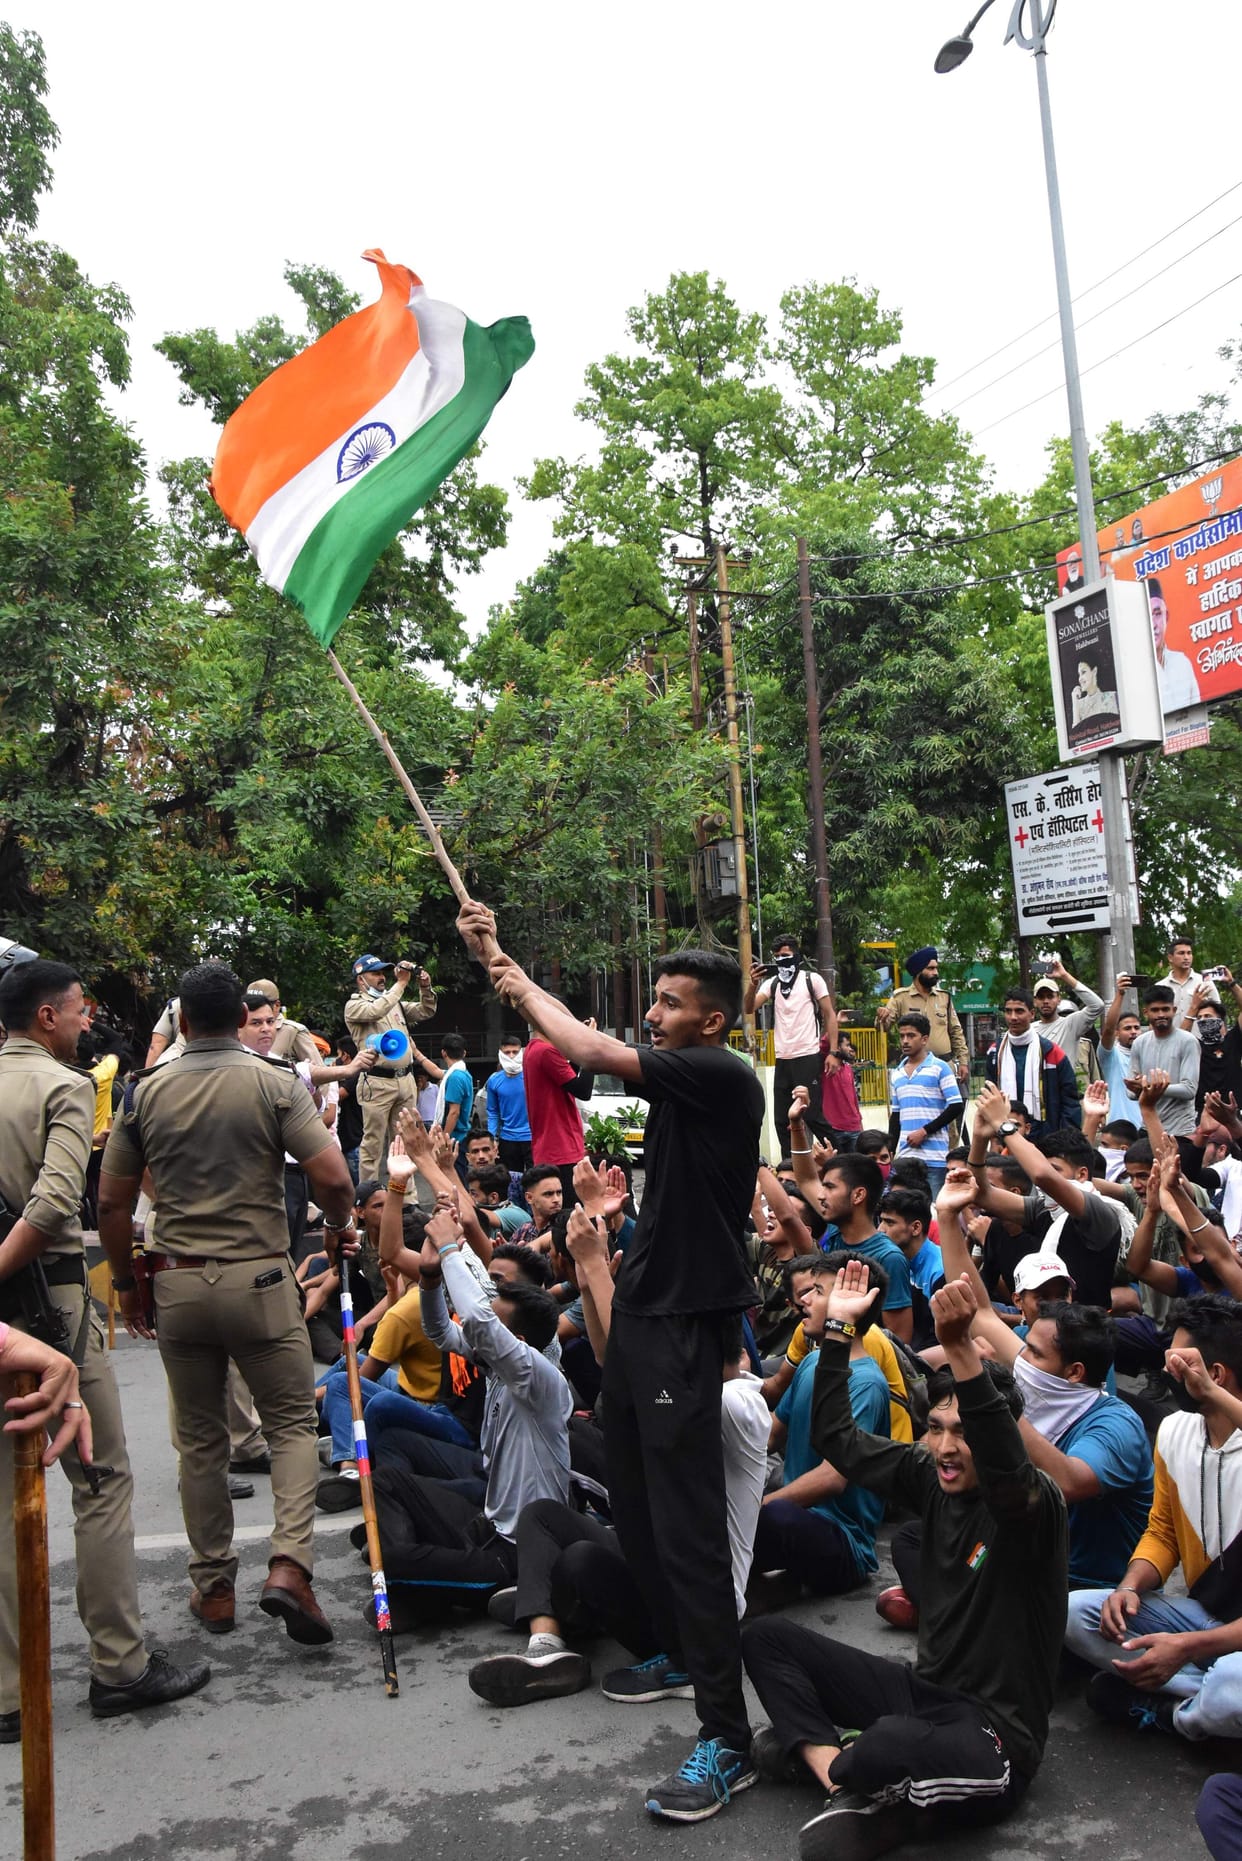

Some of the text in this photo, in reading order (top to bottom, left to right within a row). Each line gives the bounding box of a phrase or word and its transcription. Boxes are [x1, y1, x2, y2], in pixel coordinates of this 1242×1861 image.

[1134, 548, 1170, 580] प्रदेश
[1185, 564, 1199, 585] में
[1058, 621, 1081, 640] SONA
[1189, 610, 1233, 643] स्वागत
[1011, 801, 1031, 819] एस.
[1034, 793, 1050, 813] के.
[1053, 785, 1083, 809] नर्सिंग
[1029, 814, 1088, 840] एवं हॉस्पिटल
